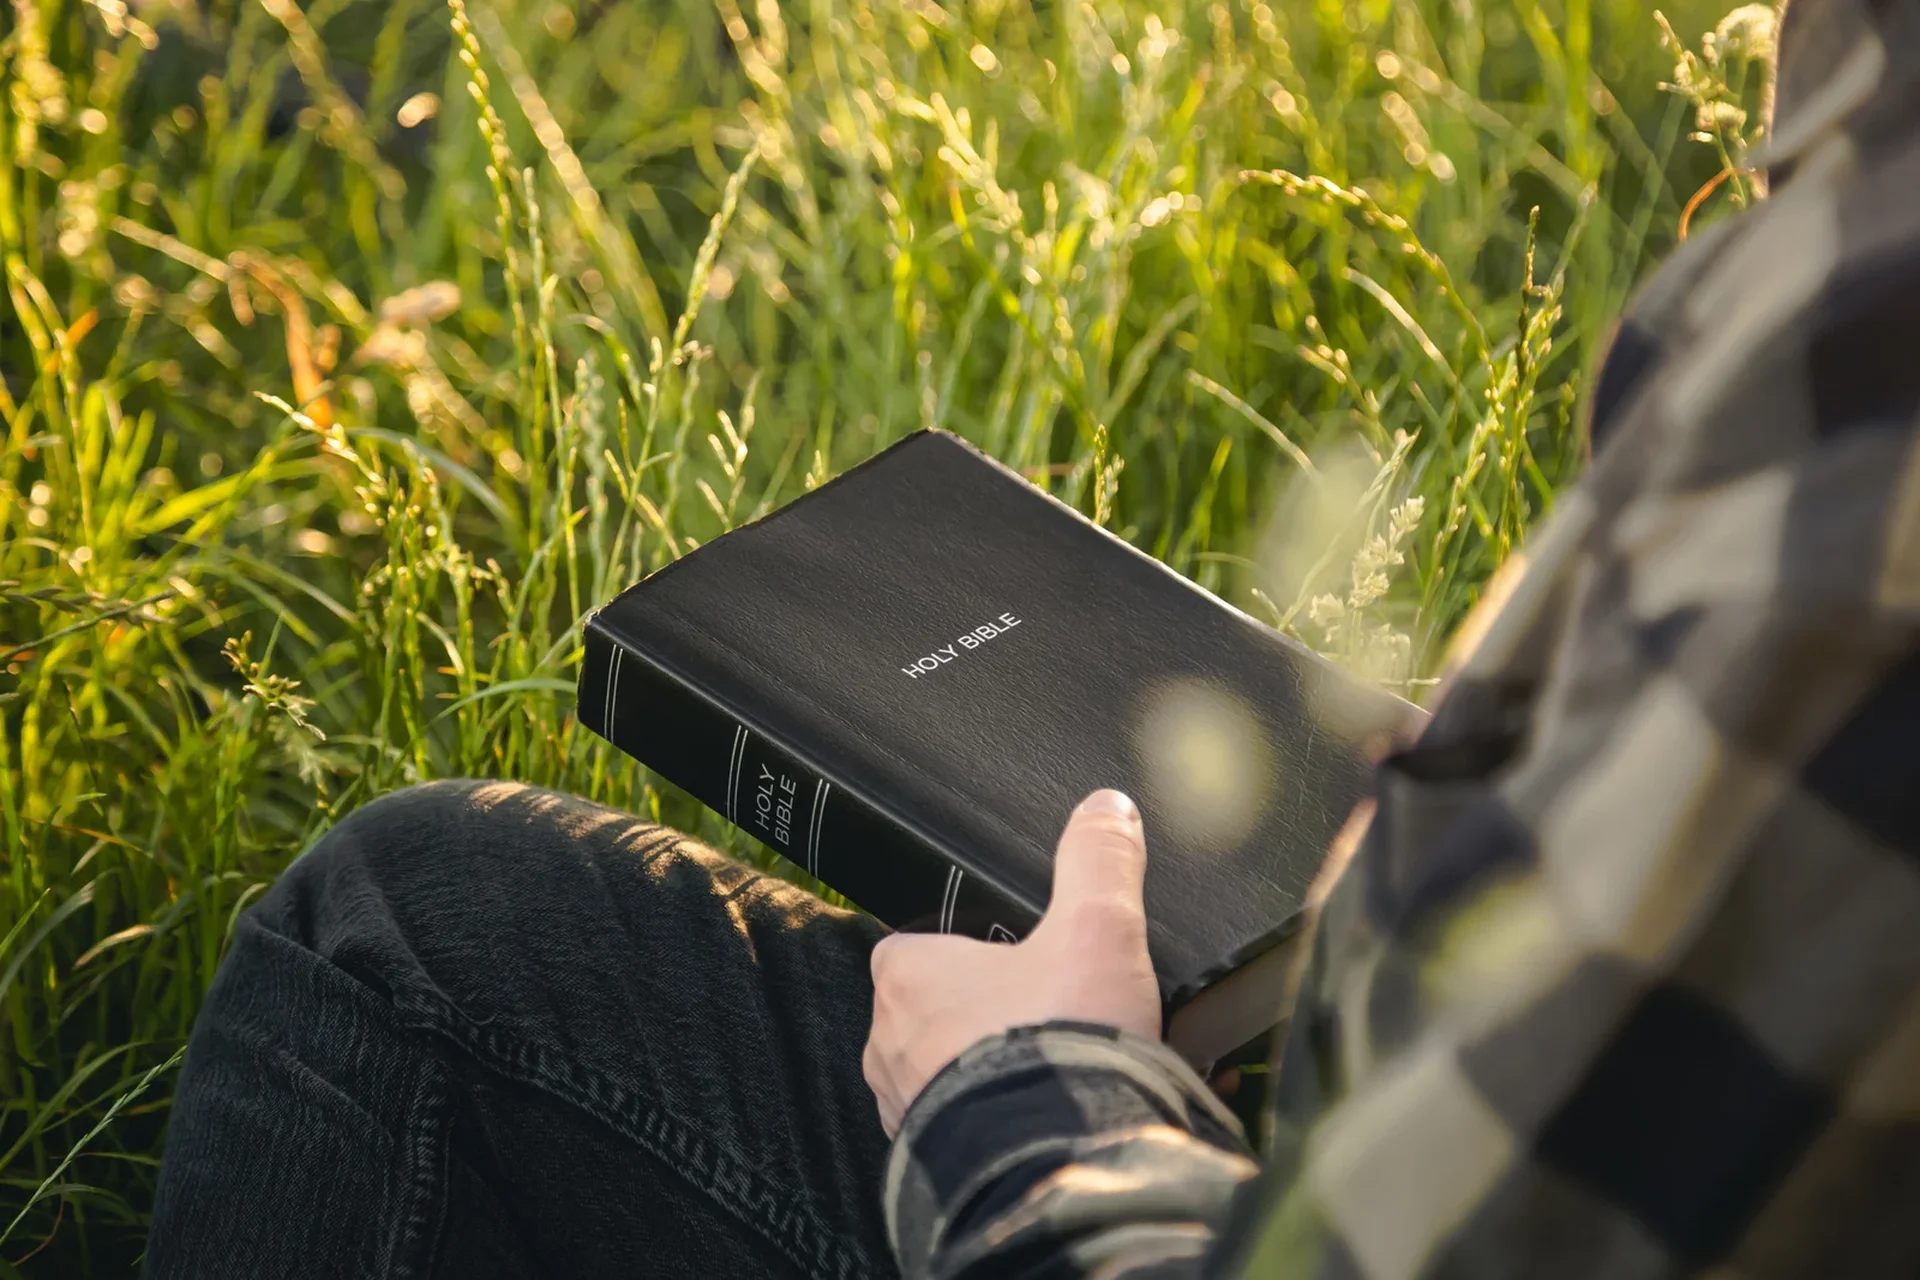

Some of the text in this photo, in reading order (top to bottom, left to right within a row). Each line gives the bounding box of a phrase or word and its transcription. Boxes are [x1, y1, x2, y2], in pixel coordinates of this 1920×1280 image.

[901, 612, 1021, 678] HOLY BIBLE
[755, 763, 775, 831] HOLY
[774, 774, 796, 846] BIBLE
